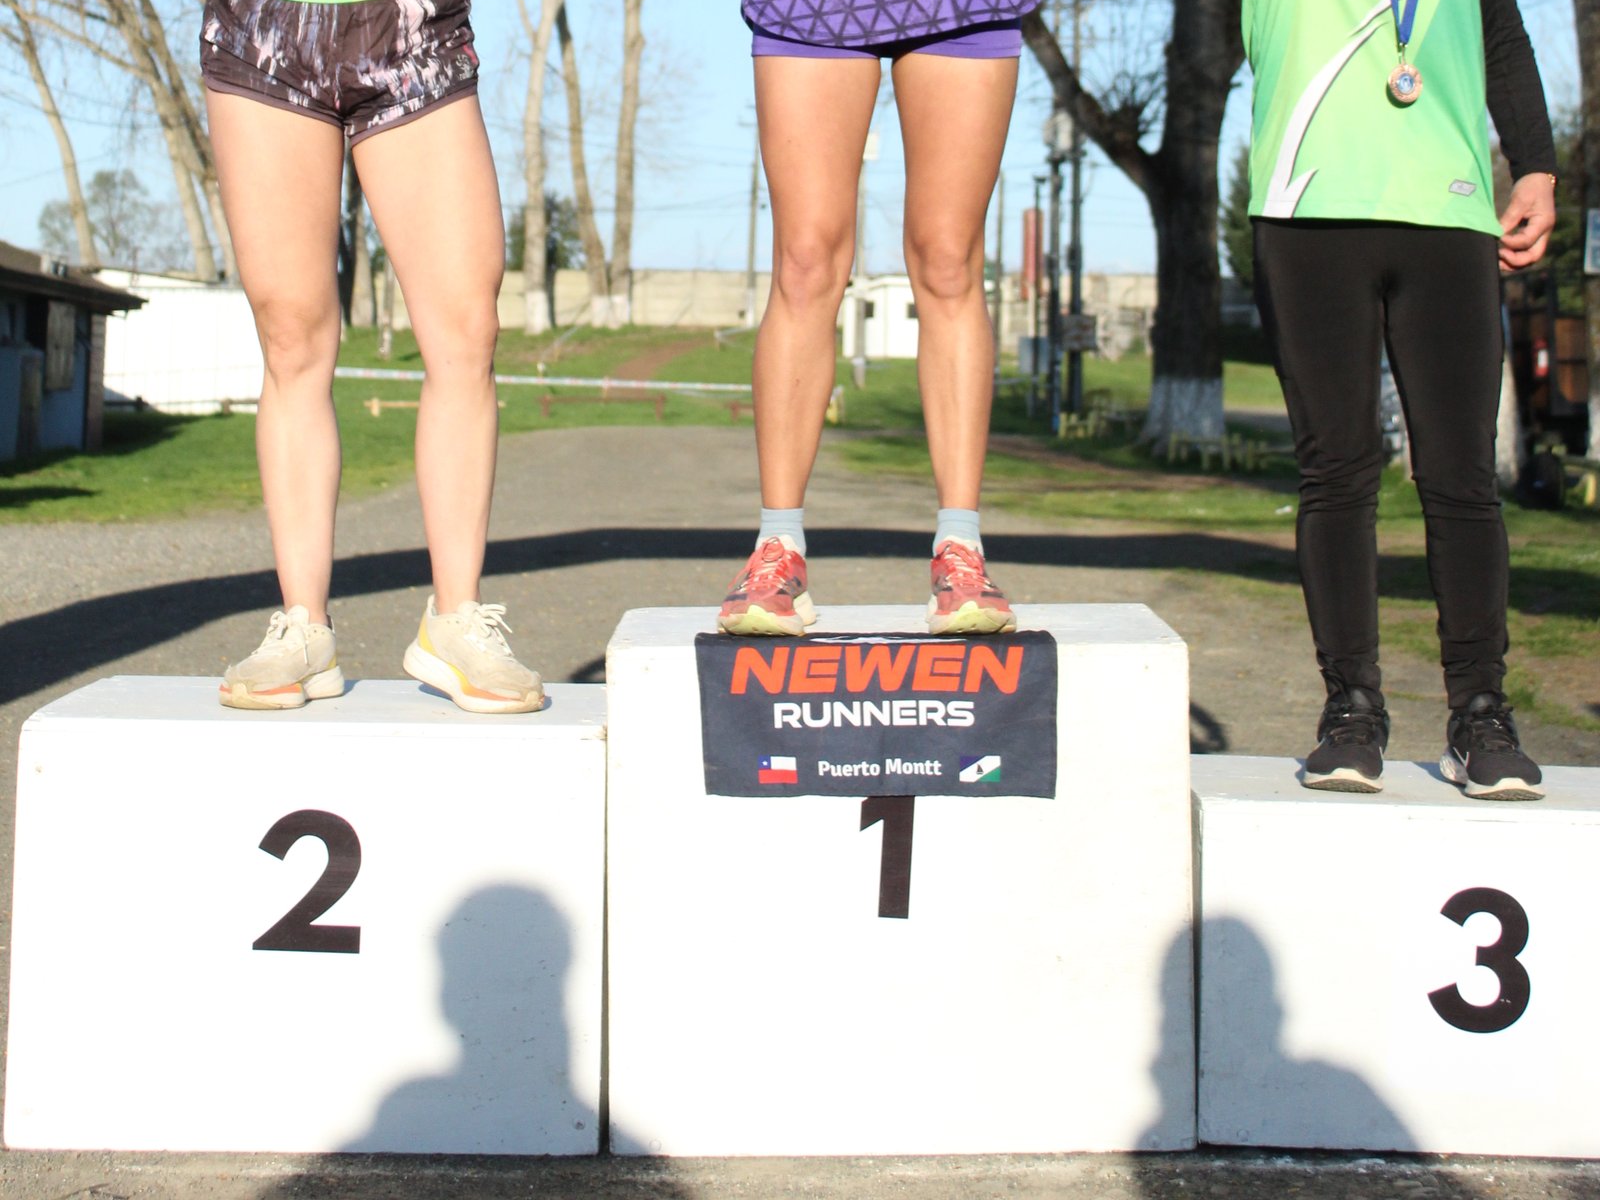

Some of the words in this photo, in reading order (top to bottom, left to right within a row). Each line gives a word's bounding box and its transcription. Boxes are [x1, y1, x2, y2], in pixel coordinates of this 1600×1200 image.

[730, 645, 1024, 694] NEWEN
[773, 700, 976, 729] RUNNERS
[817, 760, 880, 777] Puerto
[884, 758, 942, 776] Montt
[252, 808, 362, 954] 2
[859, 795, 915, 919] 1
[1427, 886, 1531, 1034] 3
